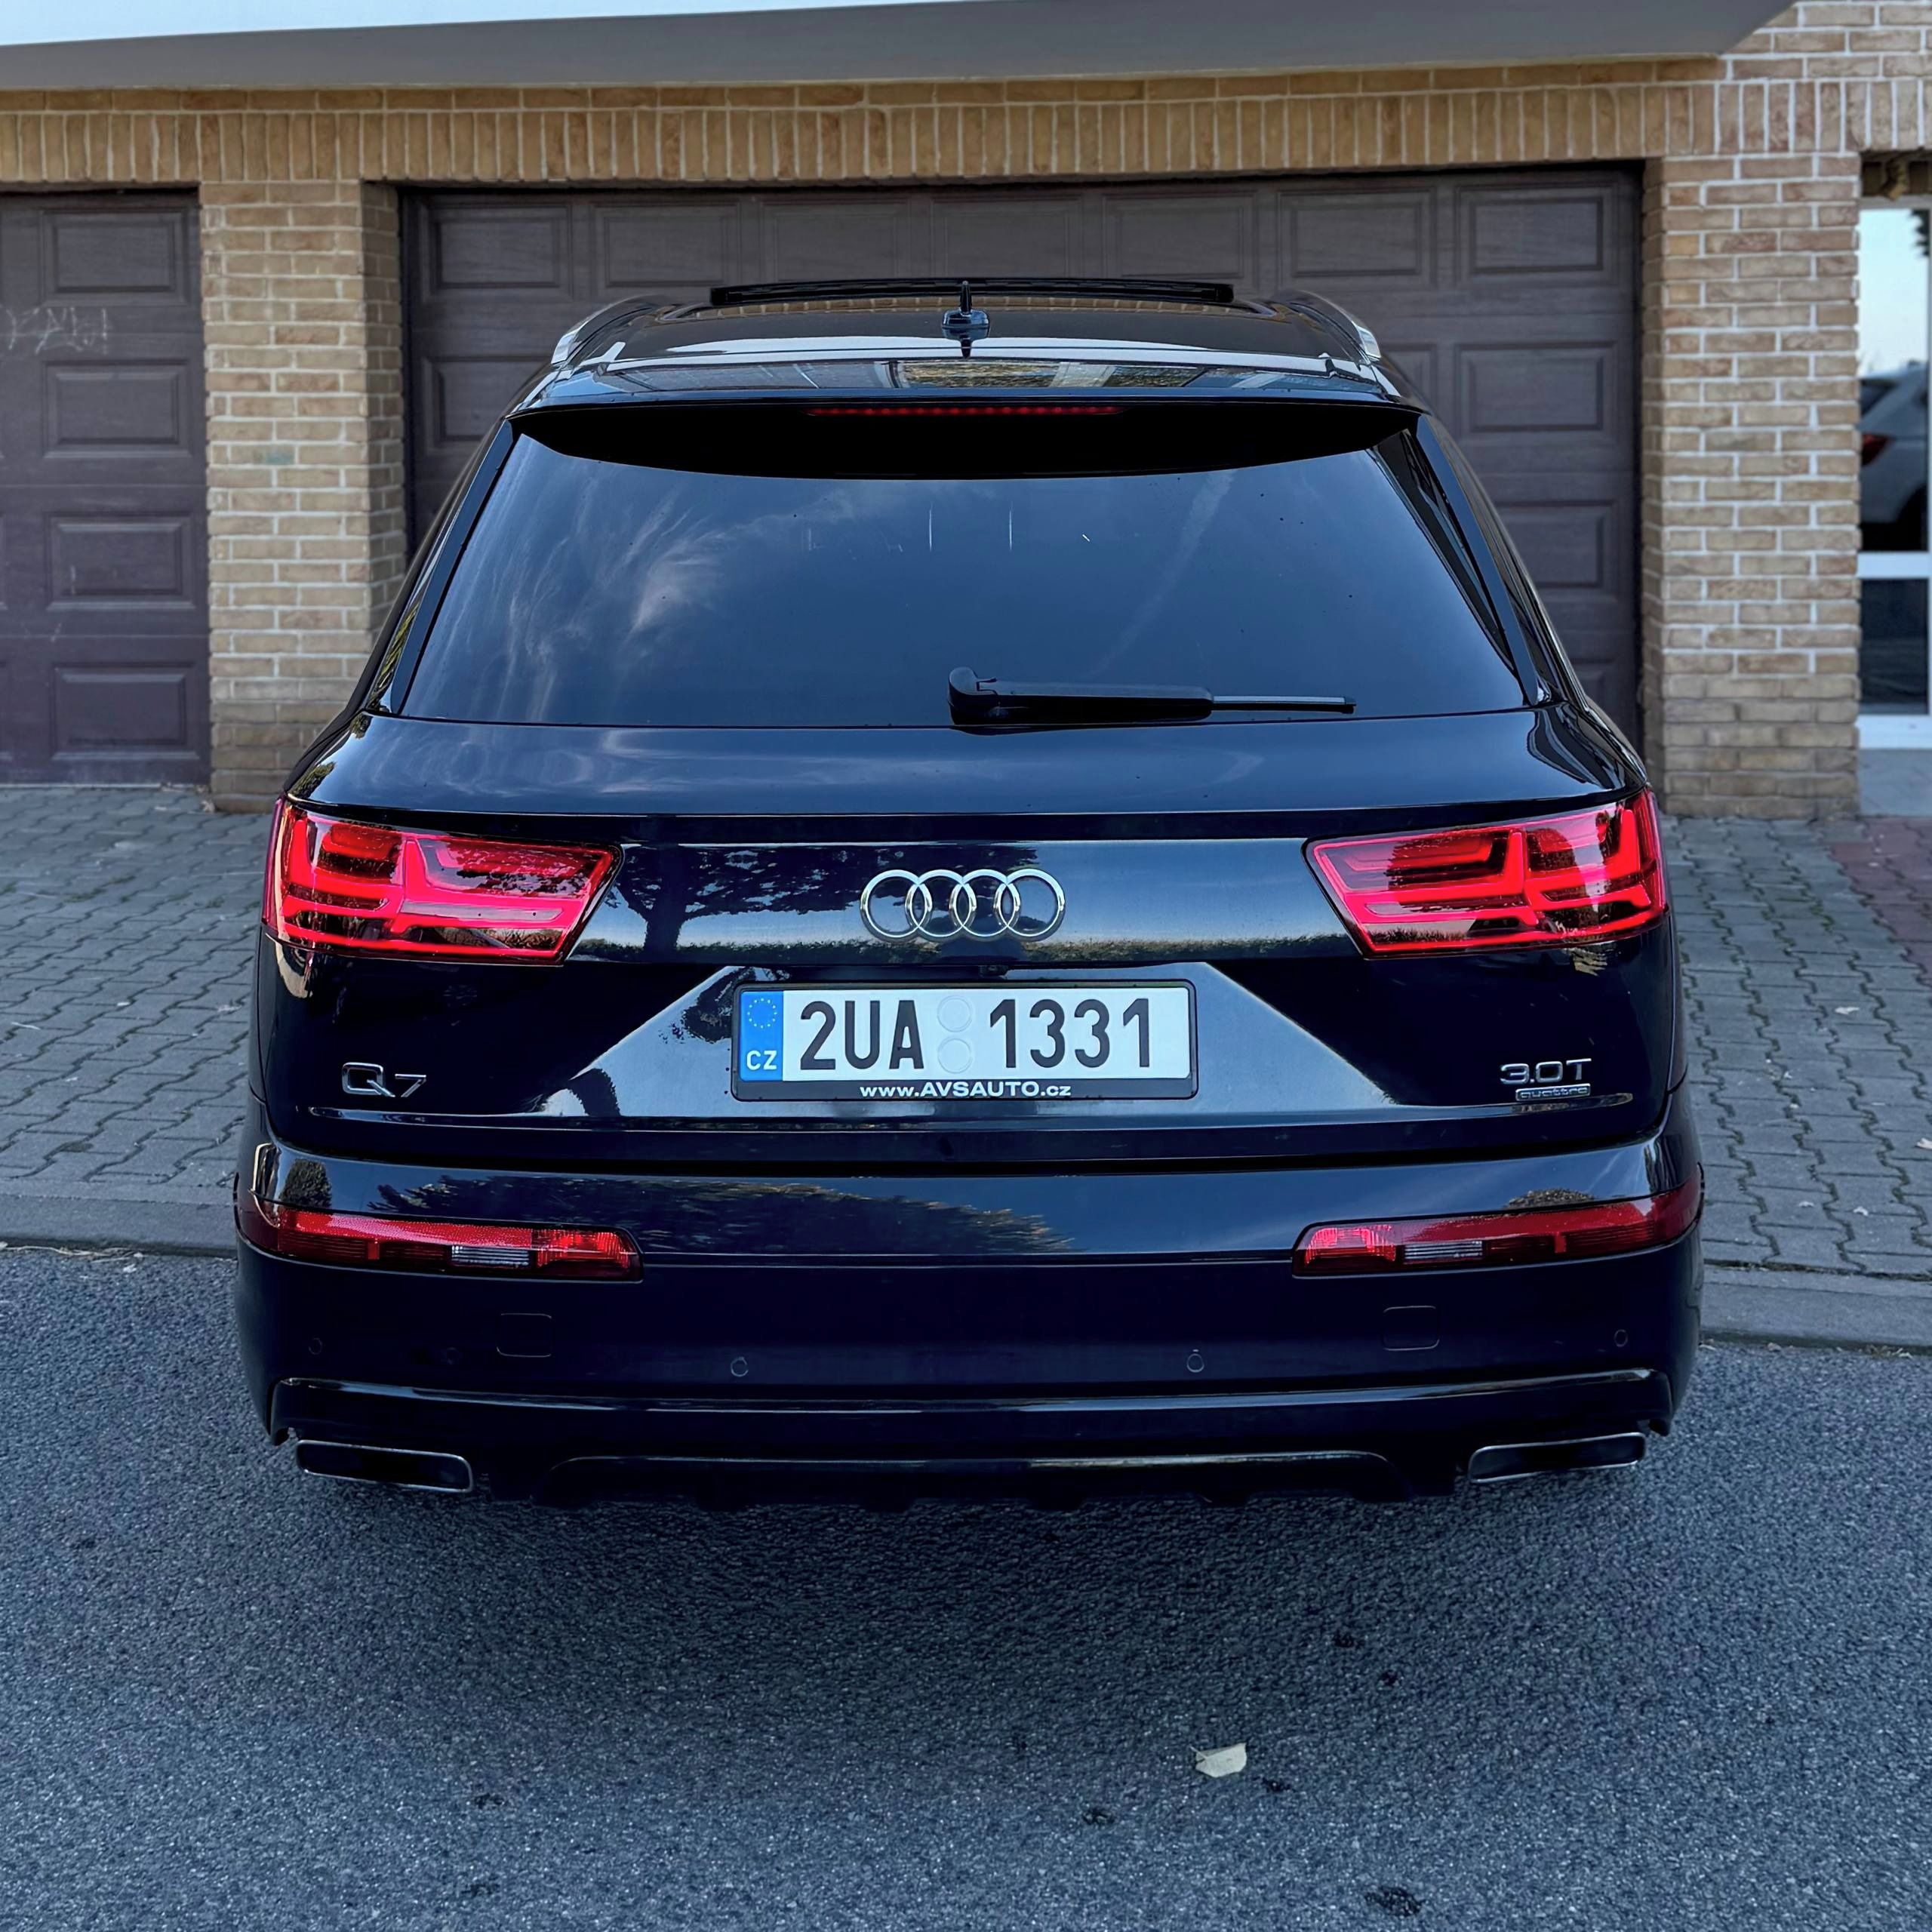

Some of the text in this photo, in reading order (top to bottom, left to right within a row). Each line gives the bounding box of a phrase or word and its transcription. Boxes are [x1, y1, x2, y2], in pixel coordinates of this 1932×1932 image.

[800, 998, 1151, 1070] 2UA 1331
[746, 1050, 777, 1071] CZ
[1500, 1058, 1592, 1084] 3.0T
[342, 1062, 426, 1097] Q7
[860, 1081, 1072, 1097] www.AVSAUTO.cz
[1520, 1088, 1588, 1099] quattro
